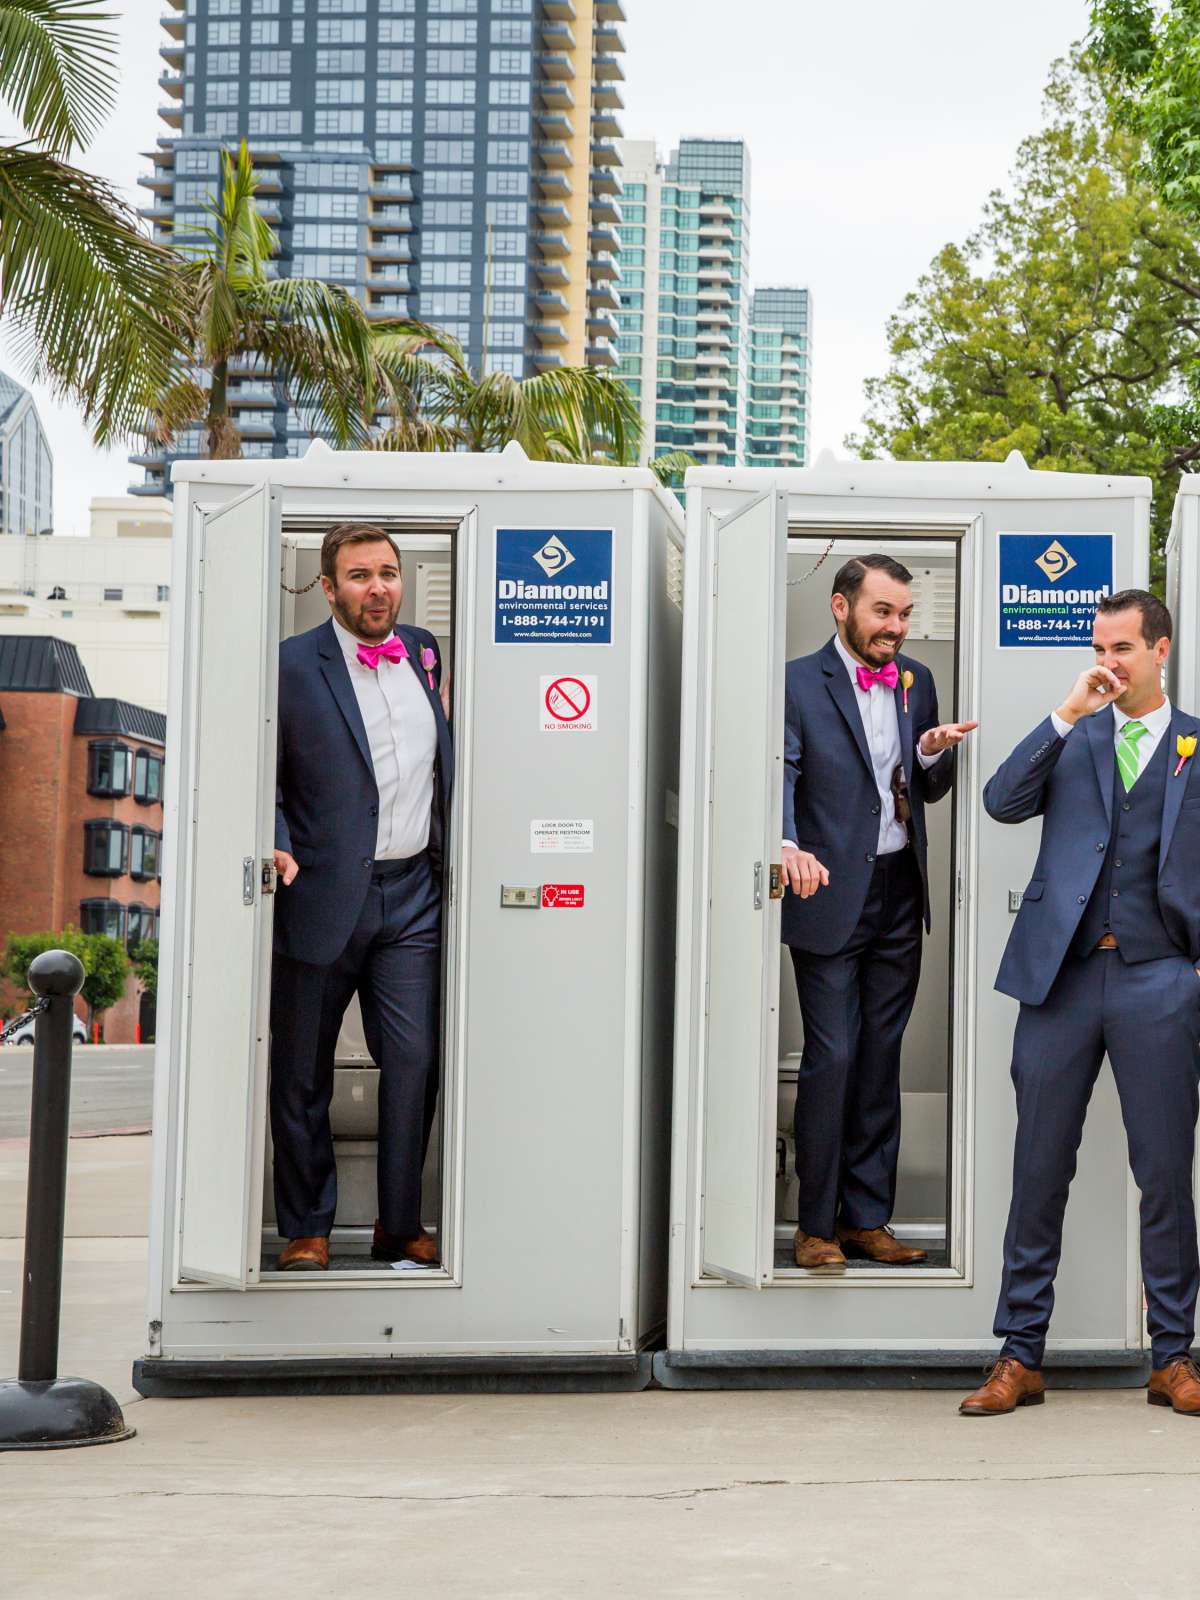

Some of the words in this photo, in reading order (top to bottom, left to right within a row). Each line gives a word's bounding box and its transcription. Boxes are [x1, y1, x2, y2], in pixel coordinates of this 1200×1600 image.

[498, 580, 608, 600] Diamond
[499, 602, 566, 610] environmental
[570, 602, 608, 610] services
[1003, 605, 1068, 614] environmental
[502, 616, 604, 626] 1-888-744-7191
